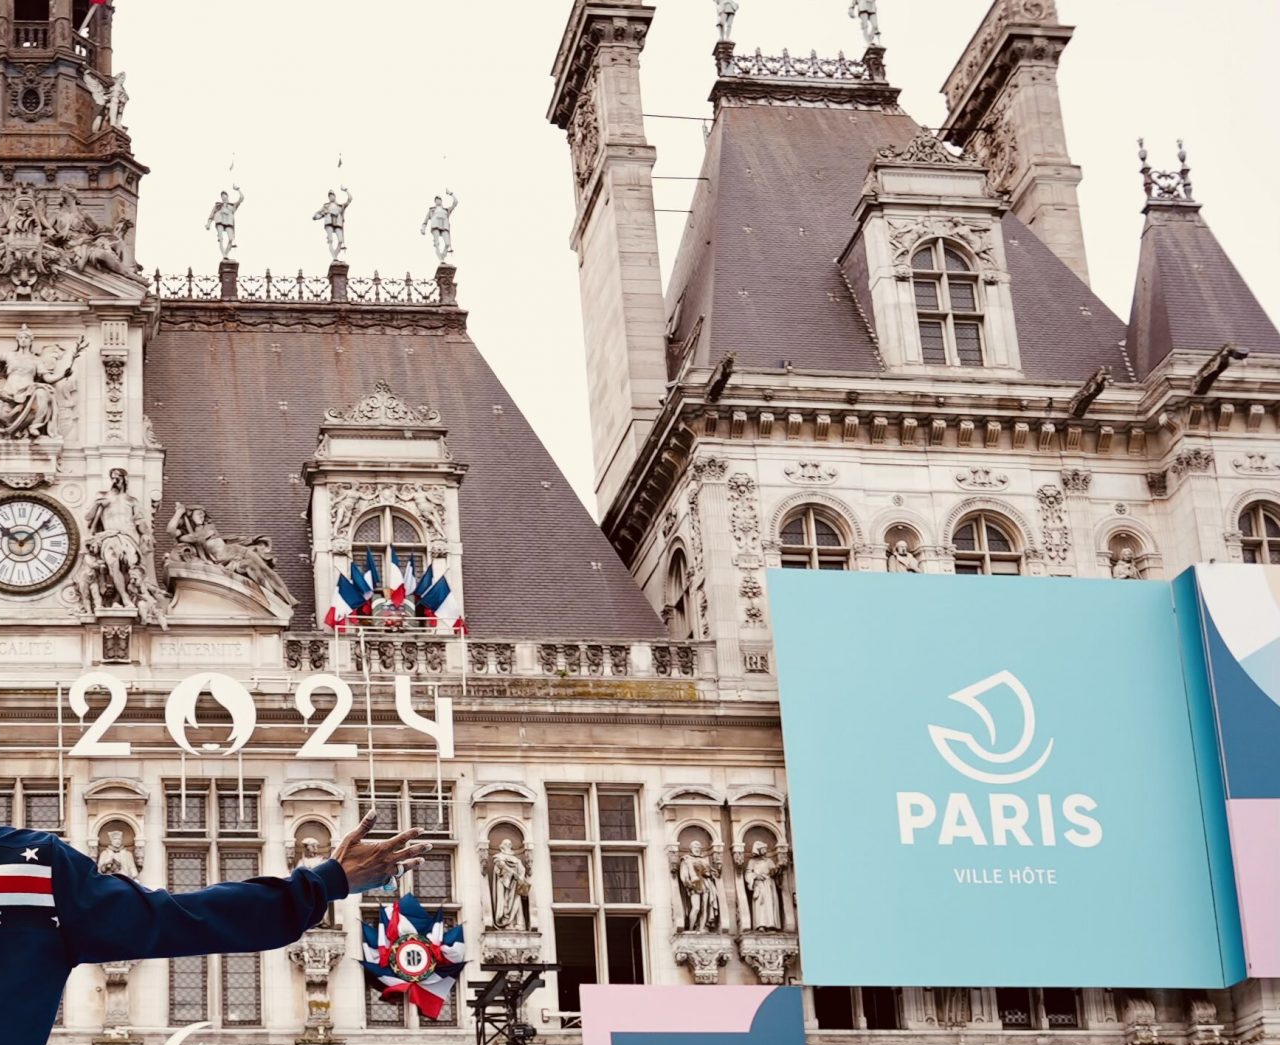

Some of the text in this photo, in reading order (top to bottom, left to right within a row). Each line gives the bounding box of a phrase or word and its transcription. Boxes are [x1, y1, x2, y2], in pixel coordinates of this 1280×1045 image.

[159, 640, 243, 656] FRATERNITÉ
[68, 672, 454, 758] 2024
[896, 791, 1103, 848] PARIS
[954, 865, 1058, 885] VILLE HÔTE
